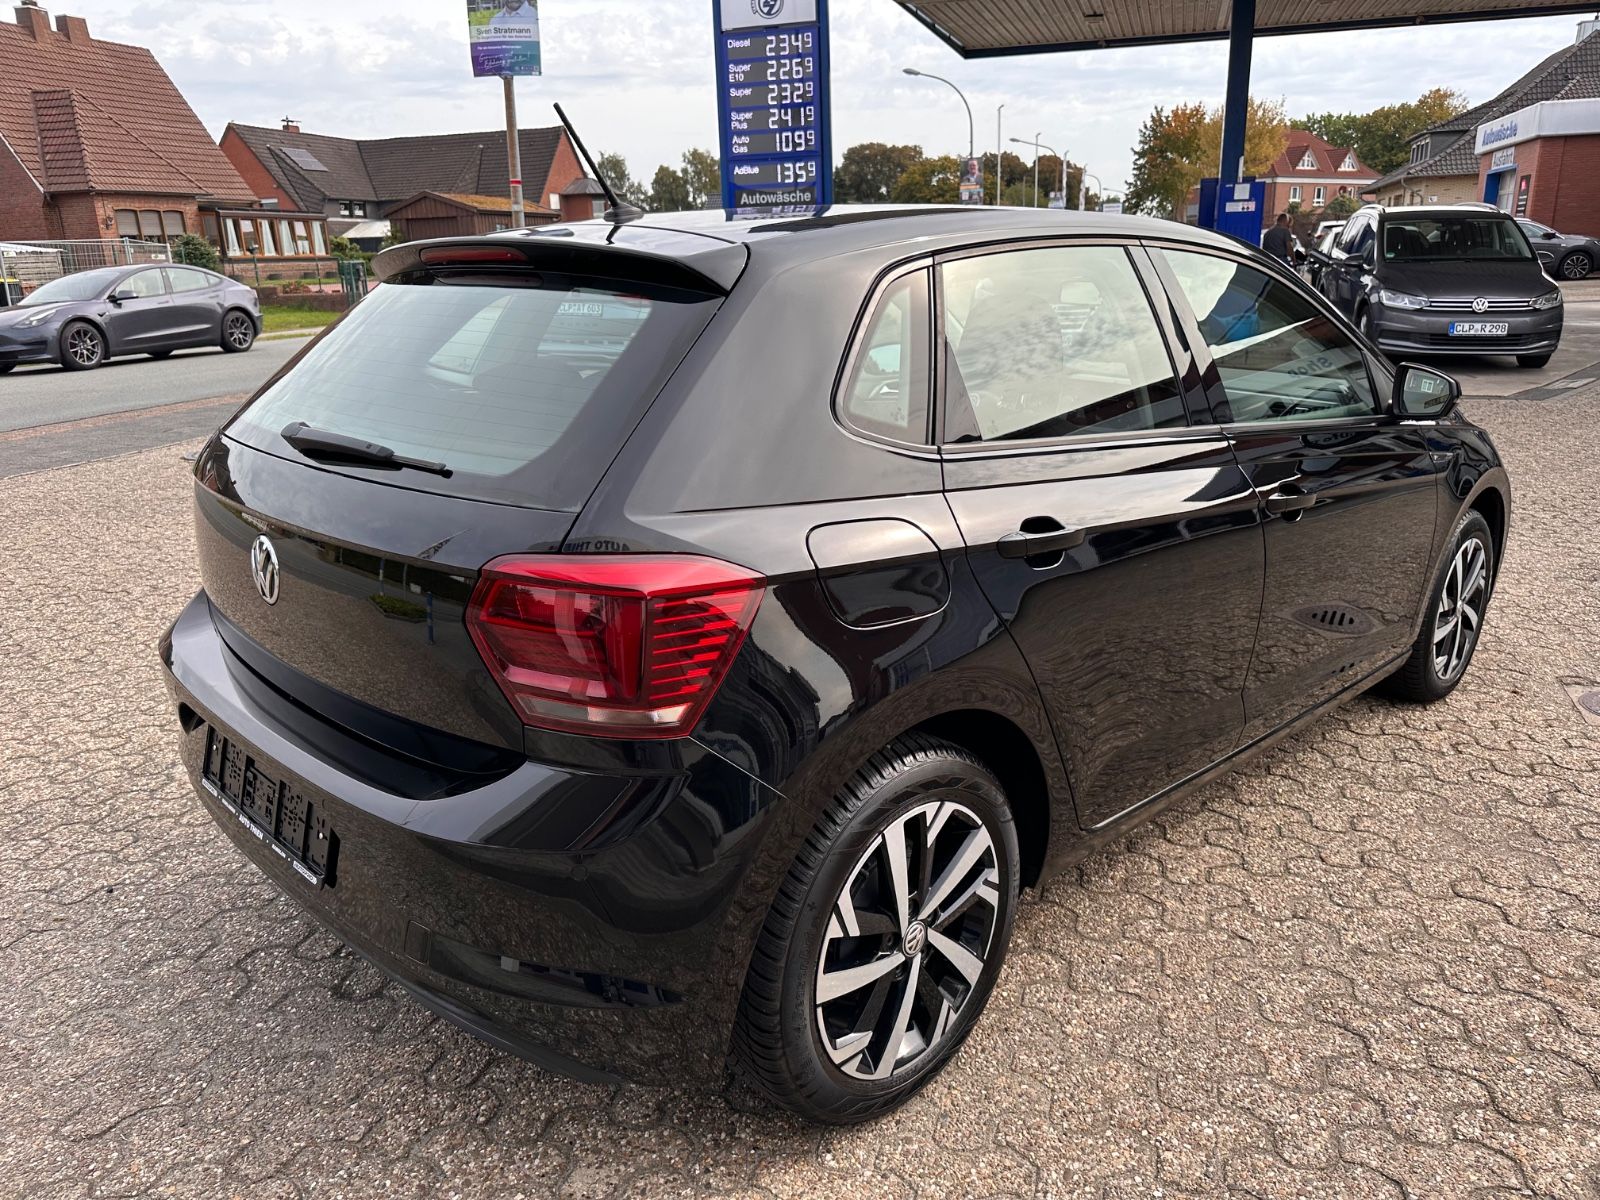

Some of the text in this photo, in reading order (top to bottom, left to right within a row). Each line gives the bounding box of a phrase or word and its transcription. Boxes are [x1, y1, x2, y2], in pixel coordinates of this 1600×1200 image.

[493, 26, 531, 34] Stratmann
[727, 38, 751, 48] Diesel
[728, 64, 751, 74] Super
[728, 73, 744, 82] E10
[729, 88, 752, 98] Super
[730, 111, 753, 121] Super
[731, 121, 748, 130] Plus
[731, 135, 750, 144] Auto
[732, 144, 748, 153] Gas
[733, 165, 760, 175] AdBlue
[740, 190, 812, 205] Autowäsche
[1455, 323, 1507, 333] CLP R 298
